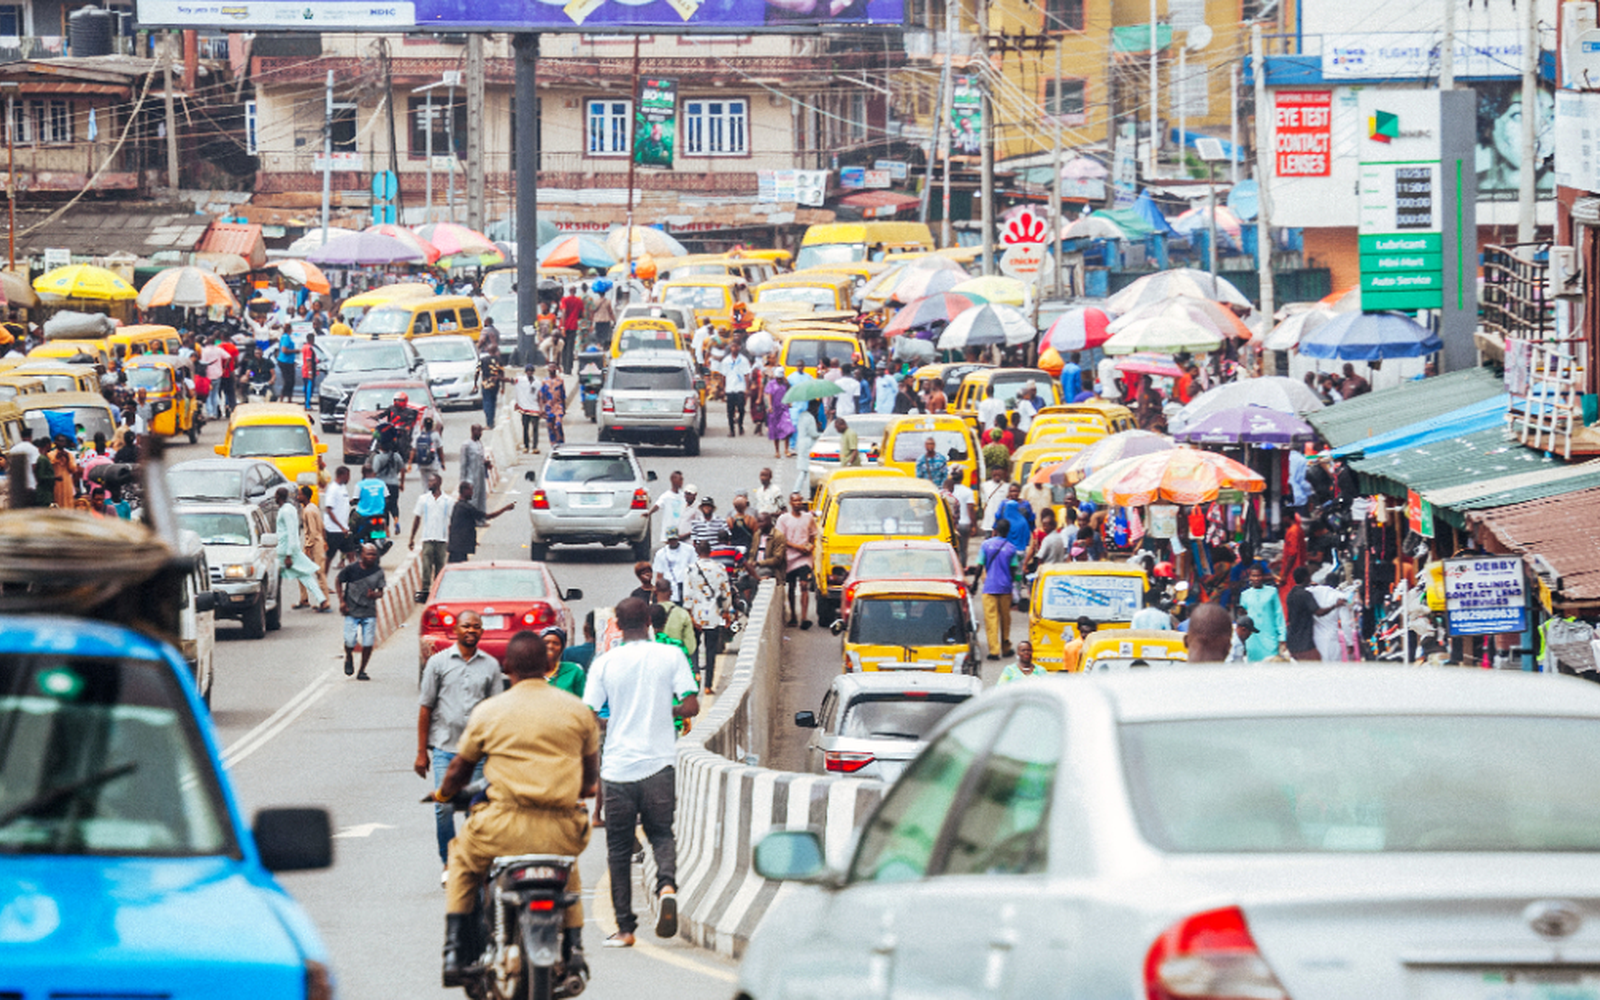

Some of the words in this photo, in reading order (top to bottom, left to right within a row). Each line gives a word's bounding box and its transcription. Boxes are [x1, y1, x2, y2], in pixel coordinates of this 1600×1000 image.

[1276, 107, 1300, 128] EYE
[1301, 107, 1330, 128] TEST
[1276, 133, 1330, 153] CONTACT
[1280, 154, 1325, 174] LENSES
[1375, 239, 1427, 250] Lubricant
[1371, 277, 1396, 286] Auto
[1396, 275, 1432, 285] Service
[1475, 561, 1516, 571] DEBBY
[1446, 590, 1492, 599] CONTACT
[1460, 598, 1508, 606] SERVICES
